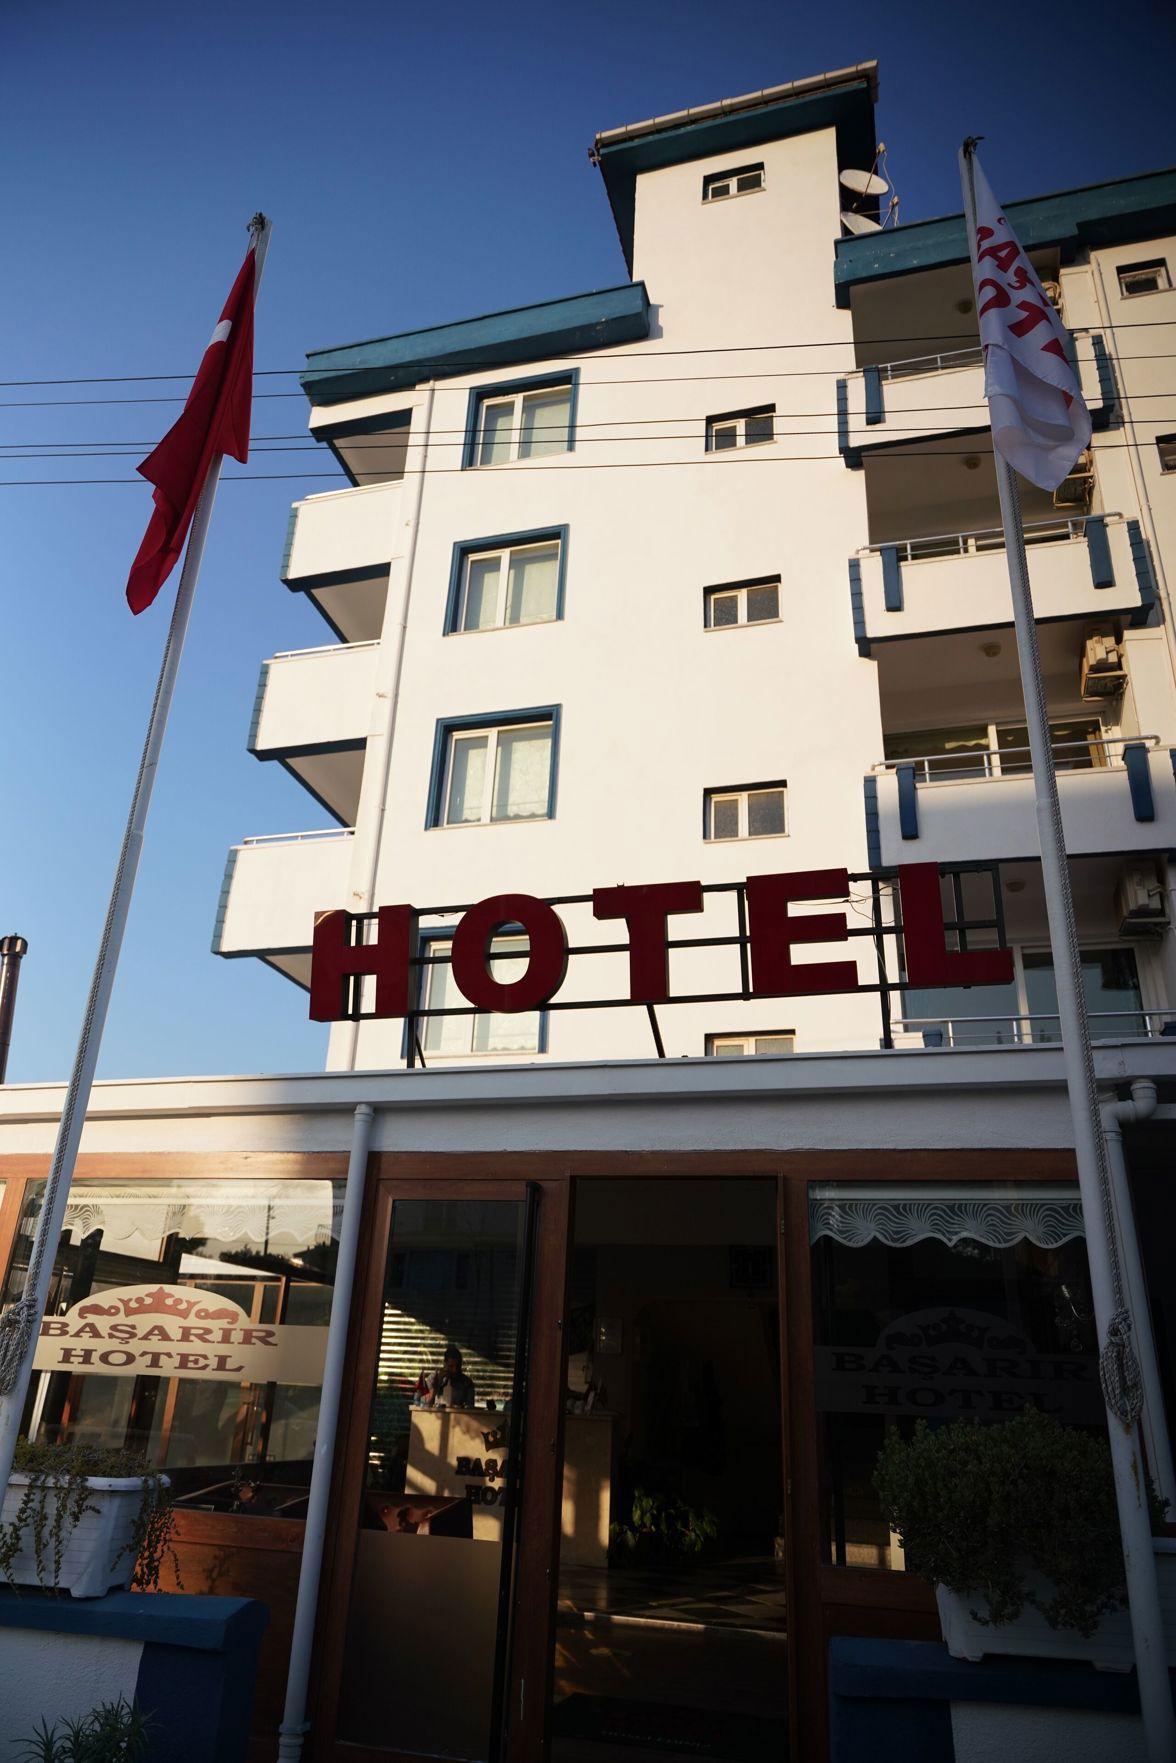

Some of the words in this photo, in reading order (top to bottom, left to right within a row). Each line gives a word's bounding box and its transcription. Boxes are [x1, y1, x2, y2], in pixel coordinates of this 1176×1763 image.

[309, 861, 1014, 1021] HOTEL
[40, 1321, 278, 1347] BAŞARIR
[57, 1348, 245, 1373] HOTEL
[832, 1352, 1095, 1382] BAŞARIR
[861, 1385, 1064, 1414] HOTEL
